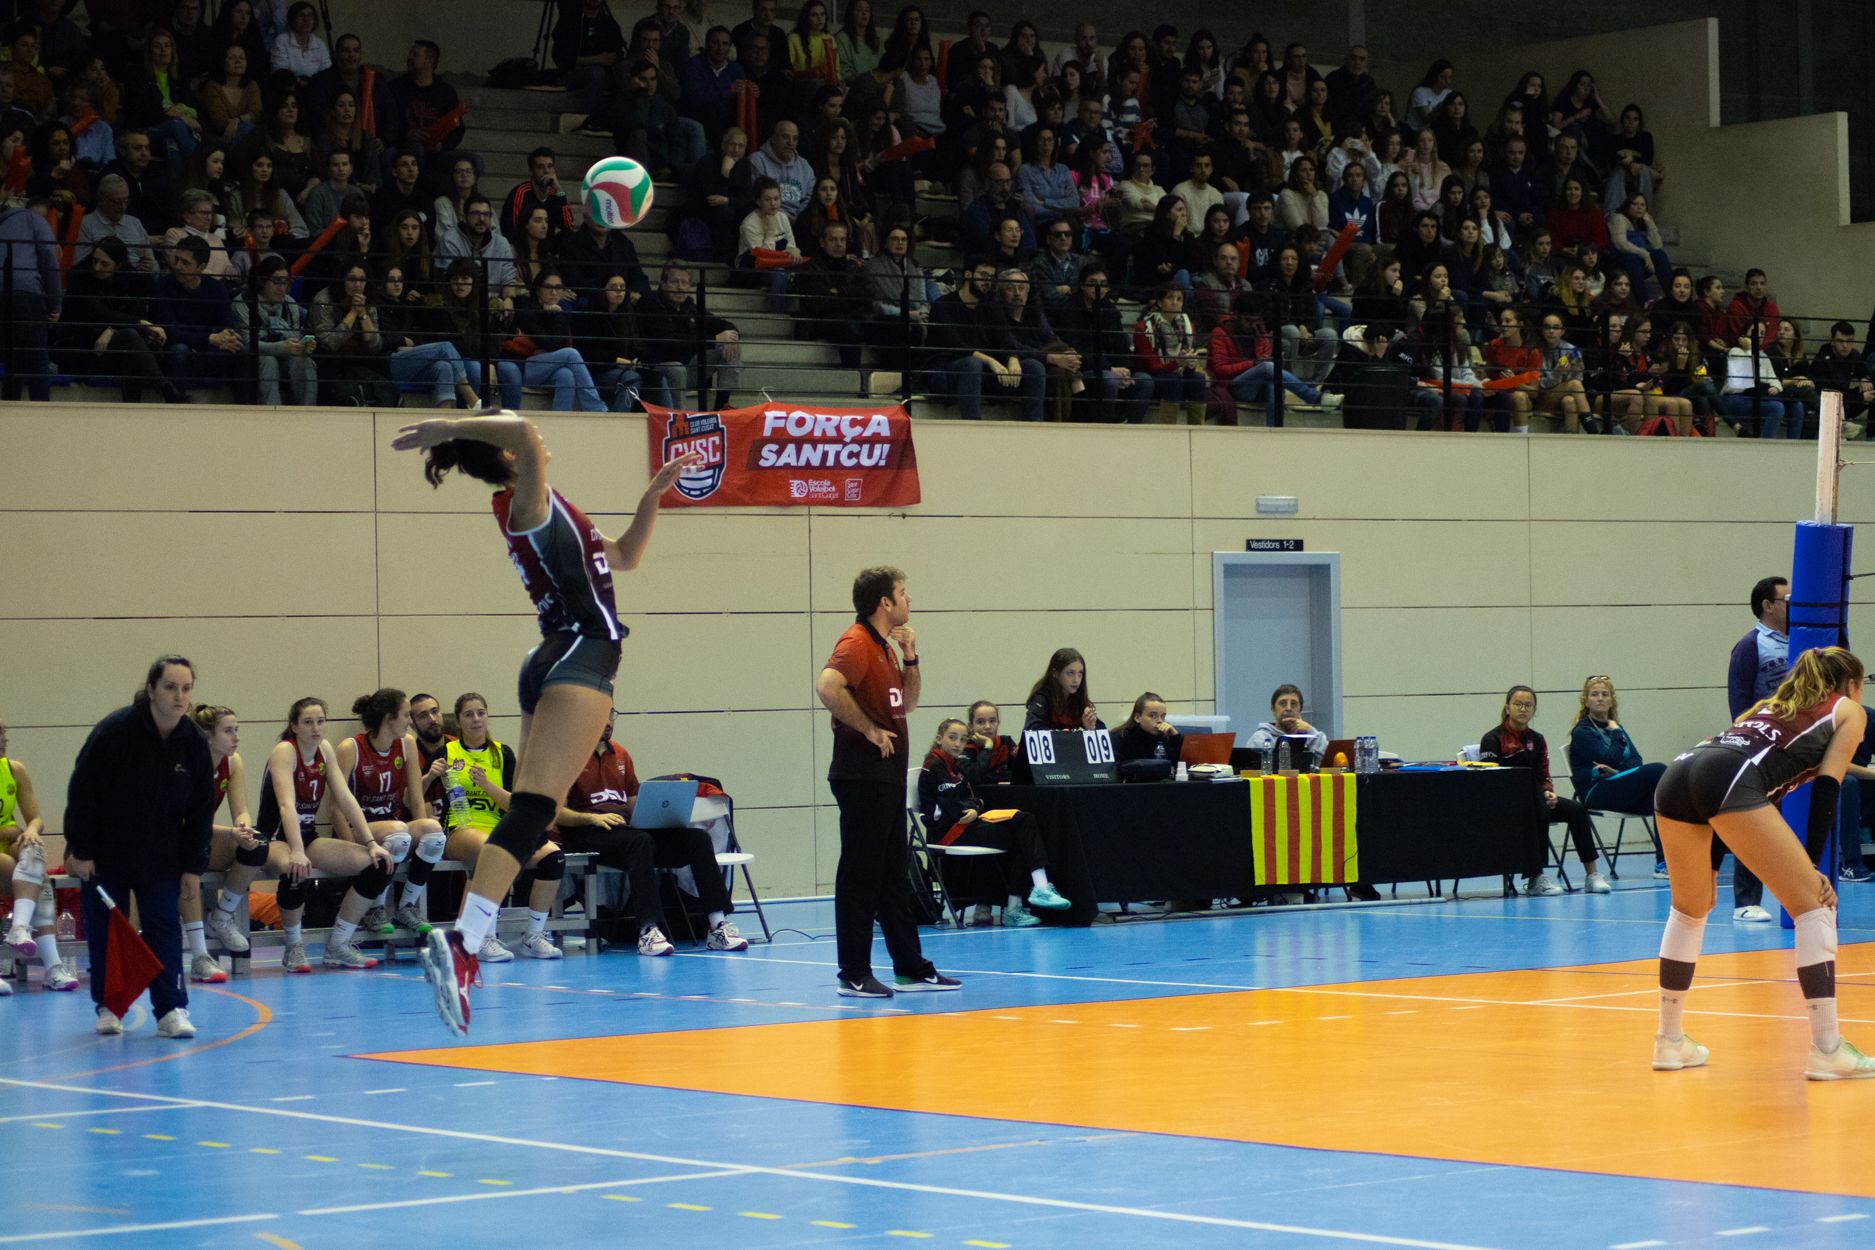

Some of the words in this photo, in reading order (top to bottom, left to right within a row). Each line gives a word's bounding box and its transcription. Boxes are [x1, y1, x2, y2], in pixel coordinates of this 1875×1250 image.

[763, 410, 891, 442] FORÇA
[758, 443, 891, 468] SANTCU!
[1250, 540, 1280, 549] Vestidors
[1283, 540, 1295, 549] 1-2
[309, 779, 319, 801] 7
[379, 771, 392, 793] 17
